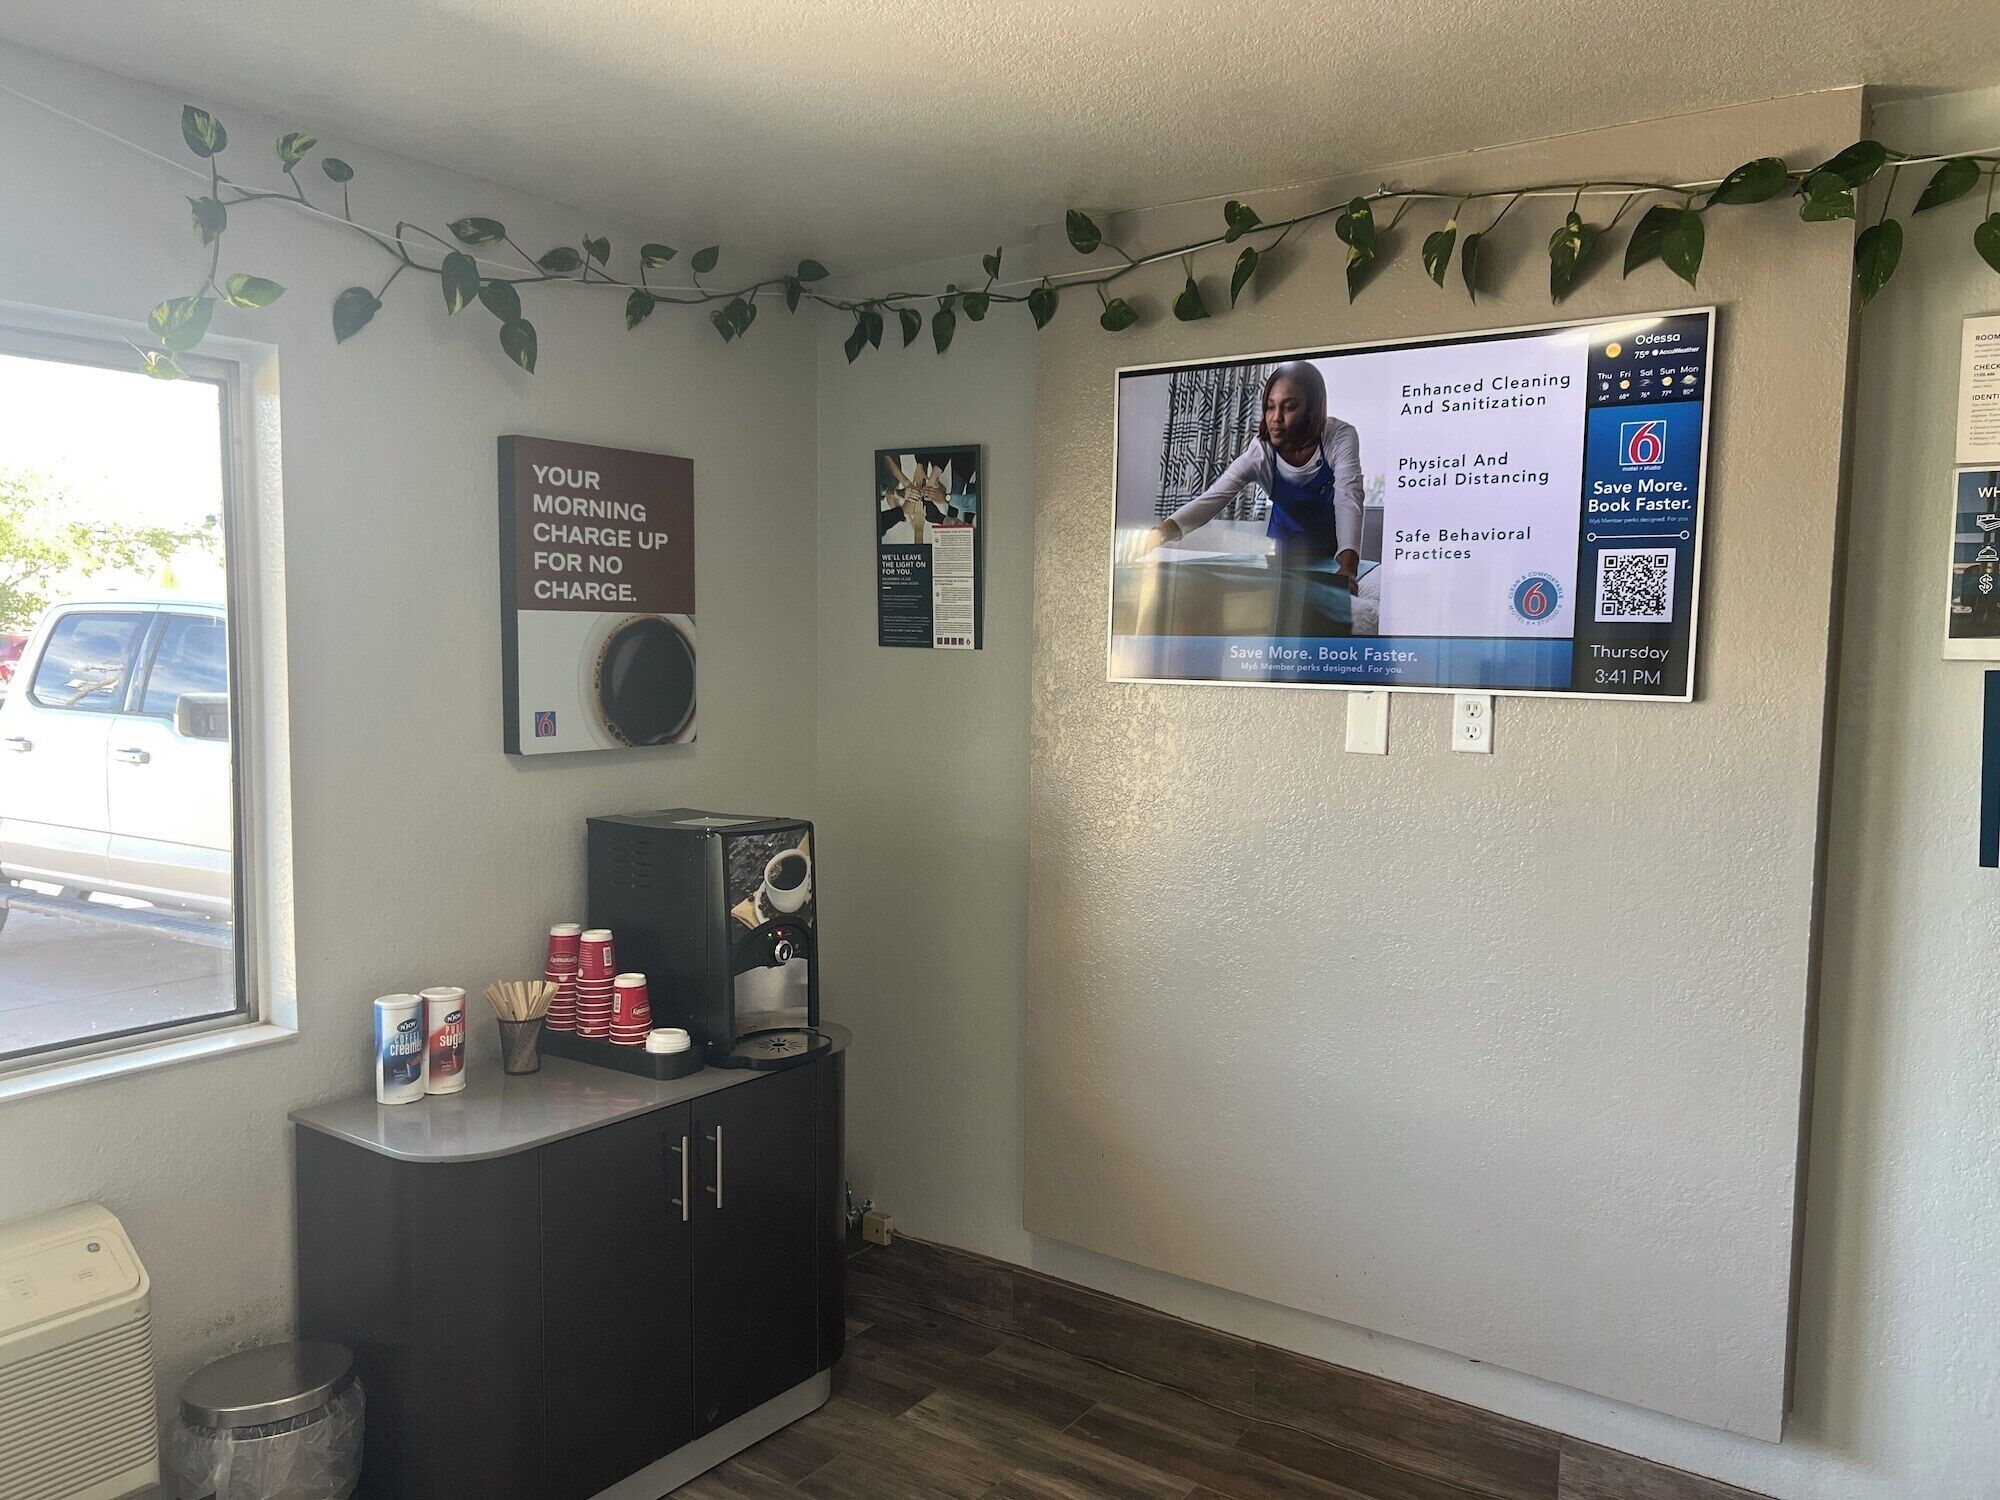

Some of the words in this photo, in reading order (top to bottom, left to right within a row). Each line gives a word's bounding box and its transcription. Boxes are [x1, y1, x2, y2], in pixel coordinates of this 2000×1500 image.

[1635, 333, 1681, 345] Odessa
[1597, 372, 1612, 380] Thu
[1620, 370, 1631, 378] Fri
[1640, 369, 1653, 377] Sat
[1660, 367, 1676, 375] Sun
[1680, 365, 1699, 374] Mon
[1402, 379, 1484, 398] Enhanced
[1492, 374, 1571, 390] Cleaning
[1401, 401, 1433, 415] And
[1442, 394, 1547, 412] Sanitization
[1628, 420, 1662, 465] 6
[1399, 454, 1466, 473] Physical
[1474, 452, 1508, 466] And
[532, 464, 601, 491] YOUR
[1398, 473, 1447, 488] Social
[1455, 470, 1549, 485] Distancing
[1593, 480, 1633, 495] Save
[1638, 479, 1688, 493] More.
[533, 493, 647, 522] MORNING
[1588, 497, 1630, 513] Book
[1636, 497, 1692, 511] Faster.
[533, 522, 632, 548] CHARGE
[638, 531, 669, 550] UP
[1395, 529, 1430, 543] Safe
[1439, 526, 1531, 541] Behavioral
[534, 552, 583, 572] FOR
[589, 554, 623, 574] NO
[1395, 547, 1471, 560] Practices
[534, 579, 637, 602] CHARGE.
[1522, 581, 1547, 617] 6
[1230, 646, 1263, 659] Save
[1268, 646, 1312, 660] More.
[1318, 647, 1358, 661] Book
[1364, 648, 1418, 663] Faster.
[1590, 644, 1669, 663] Thursday
[1241, 661, 1258, 671] My6
[1261, 662, 1295, 672] Member
[1297, 663, 1320, 672] perks
[1323, 664, 1365, 674] designed.
[1368, 664, 1383, 673] For
[1595, 669, 1627, 684] 3:41
[1633, 669, 1661, 685] PM
[538, 711, 555, 738] 6
